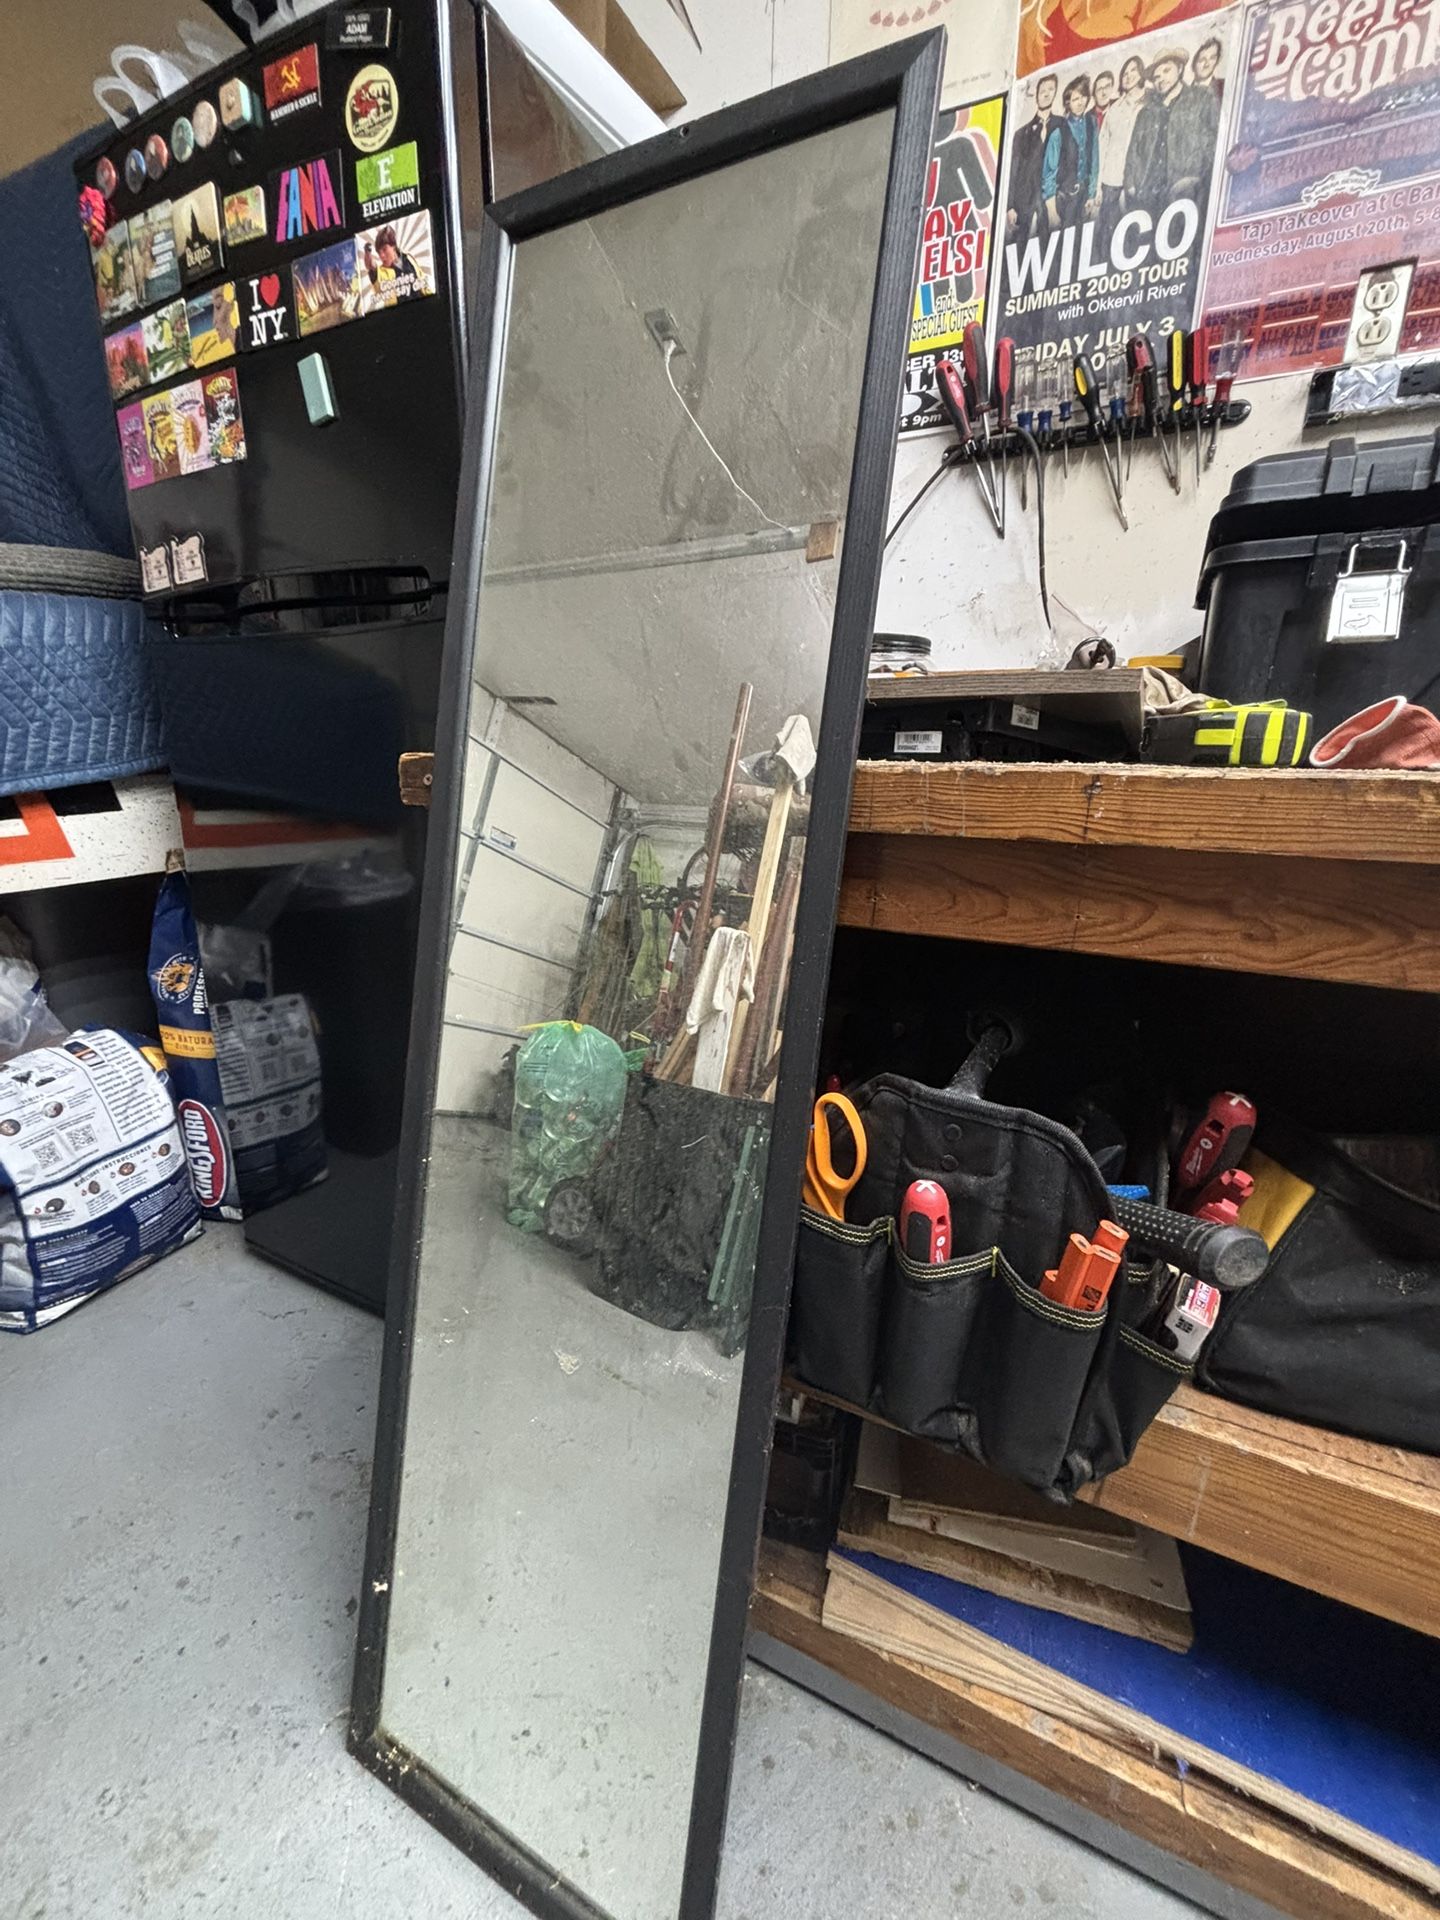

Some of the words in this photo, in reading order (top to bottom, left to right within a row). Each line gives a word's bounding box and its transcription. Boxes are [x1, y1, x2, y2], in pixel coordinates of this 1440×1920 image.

[345, 22, 368, 35] ADAM
[269, 101, 294, 121] HAMMER
[298, 91, 318, 109] SICKLE
[362, 188, 416, 218] ELEVATION
[1241, 222, 1272, 242] Tap
[1276, 202, 1363, 234] Takeover
[1366, 194, 1387, 213] at
[1392, 192, 1406, 208] C
[1005, 198, 1199, 298] WILCO
[1305, 226, 1362, 249] August
[248, 278, 262, 312] I
[379, 272, 416, 293] Goonies
[396, 283, 413, 298] say
[1004, 282, 1082, 317] SUMMER
[1085, 270, 1133, 298] 2009
[1137, 256, 1190, 287] TOUR
[935, 288, 955, 314] and
[1057, 303, 1085, 321] with
[1087, 291, 1144, 315] Okkervil
[1146, 281, 1187, 303] River
[248, 306, 288, 347] NY
[911, 312, 949, 342] SPECIAL
[948, 304, 980, 334] GUEST
[1013, 332, 1090, 364] RIDAY
[1093, 319, 1153, 352] JULY
[1158, 315, 1176, 338] 3
[942, 348, 965, 364] 13t
[912, 412, 943, 427] 9pm
[183, 1108, 216, 1200] KINGSFORD
